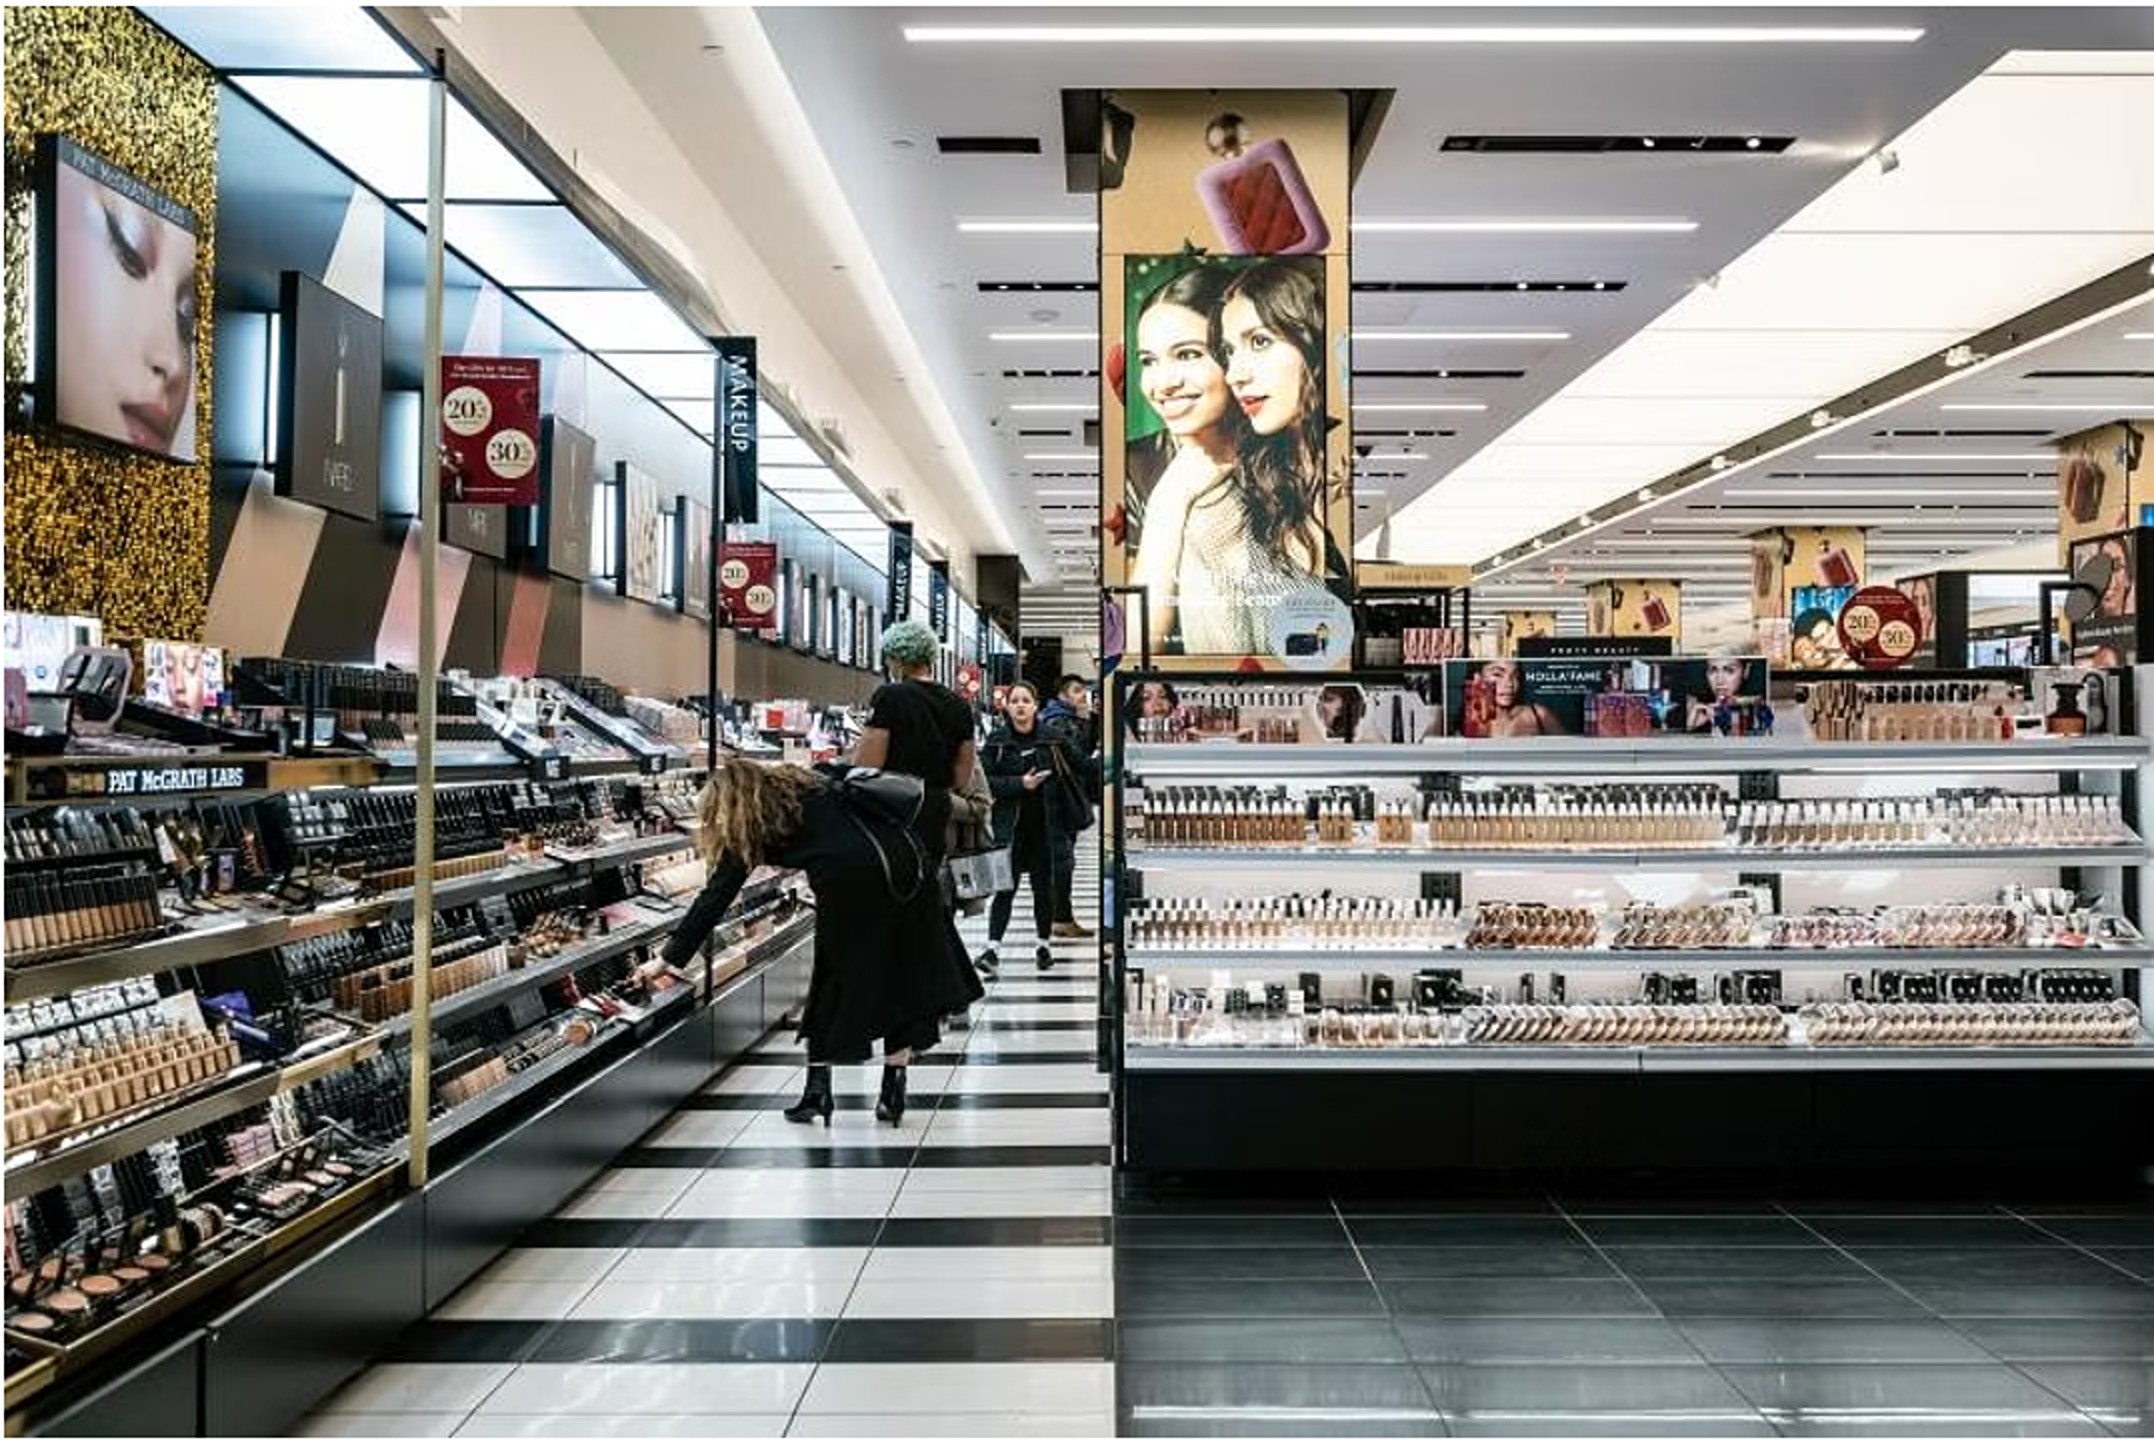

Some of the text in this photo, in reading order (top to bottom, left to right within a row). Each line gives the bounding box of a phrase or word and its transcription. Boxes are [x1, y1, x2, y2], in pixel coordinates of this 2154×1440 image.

[729, 355, 749, 452] MAKEUP
[108, 768, 244, 793] PAT McGRATH LABS
